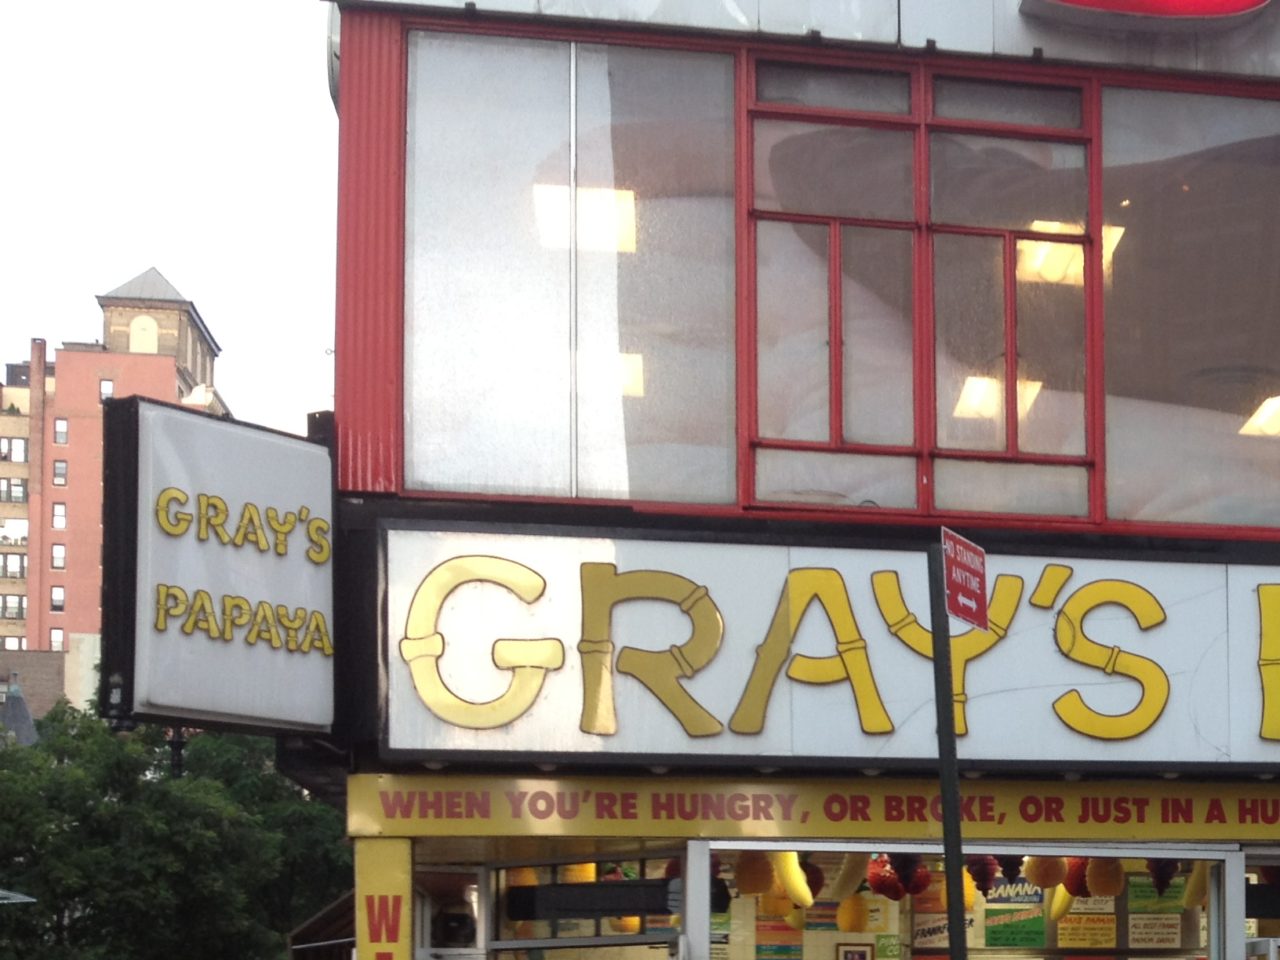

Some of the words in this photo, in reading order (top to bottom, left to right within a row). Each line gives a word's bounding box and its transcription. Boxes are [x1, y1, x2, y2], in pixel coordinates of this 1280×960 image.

[156, 486, 332, 565] GRAY'S
[951, 565, 981, 594] ANYTIME
[154, 583, 334, 657] PAPAYA
[400, 554, 1170, 740] GRAY'S
[379, 790, 490, 819] WHEN
[504, 789, 639, 820] YOU'RE
[651, 792, 811, 823] HUNGRY,
[823, 794, 871, 822] OR
[1019, 796, 1065, 823] OR
[1077, 797, 1150, 824] JUST
[1161, 797, 1193, 824] IN
[1204, 798, 1227, 824] A
